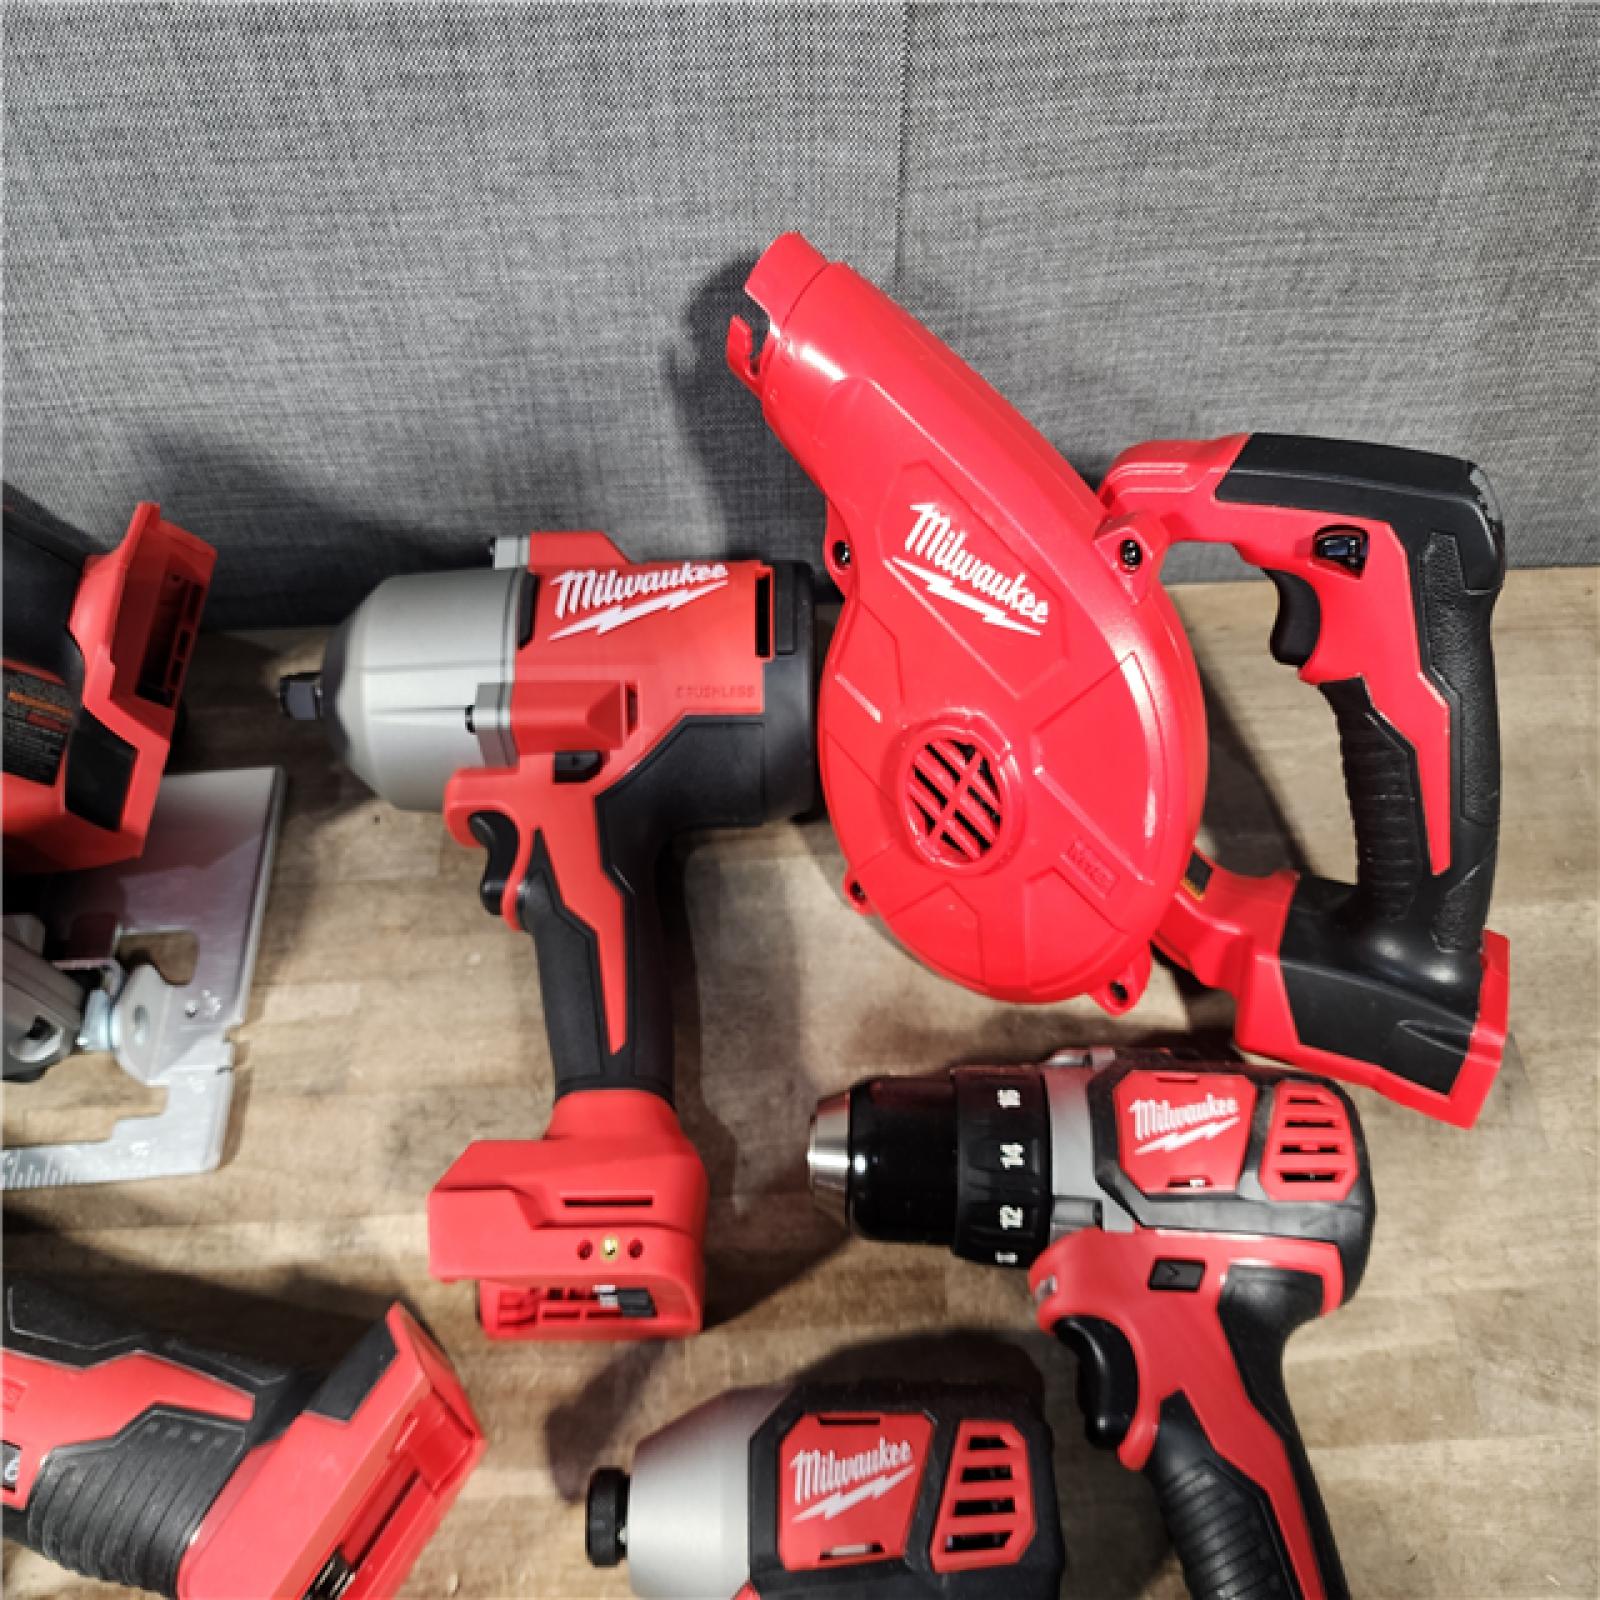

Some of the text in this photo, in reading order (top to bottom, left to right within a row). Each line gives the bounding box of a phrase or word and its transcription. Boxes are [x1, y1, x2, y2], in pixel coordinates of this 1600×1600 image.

[551, 562, 728, 619] Milwaukee
[905, 503, 1048, 623] Milwaukee
[1128, 1092, 1239, 1140] Milwaukee
[790, 1436, 912, 1504] Milwaukee
